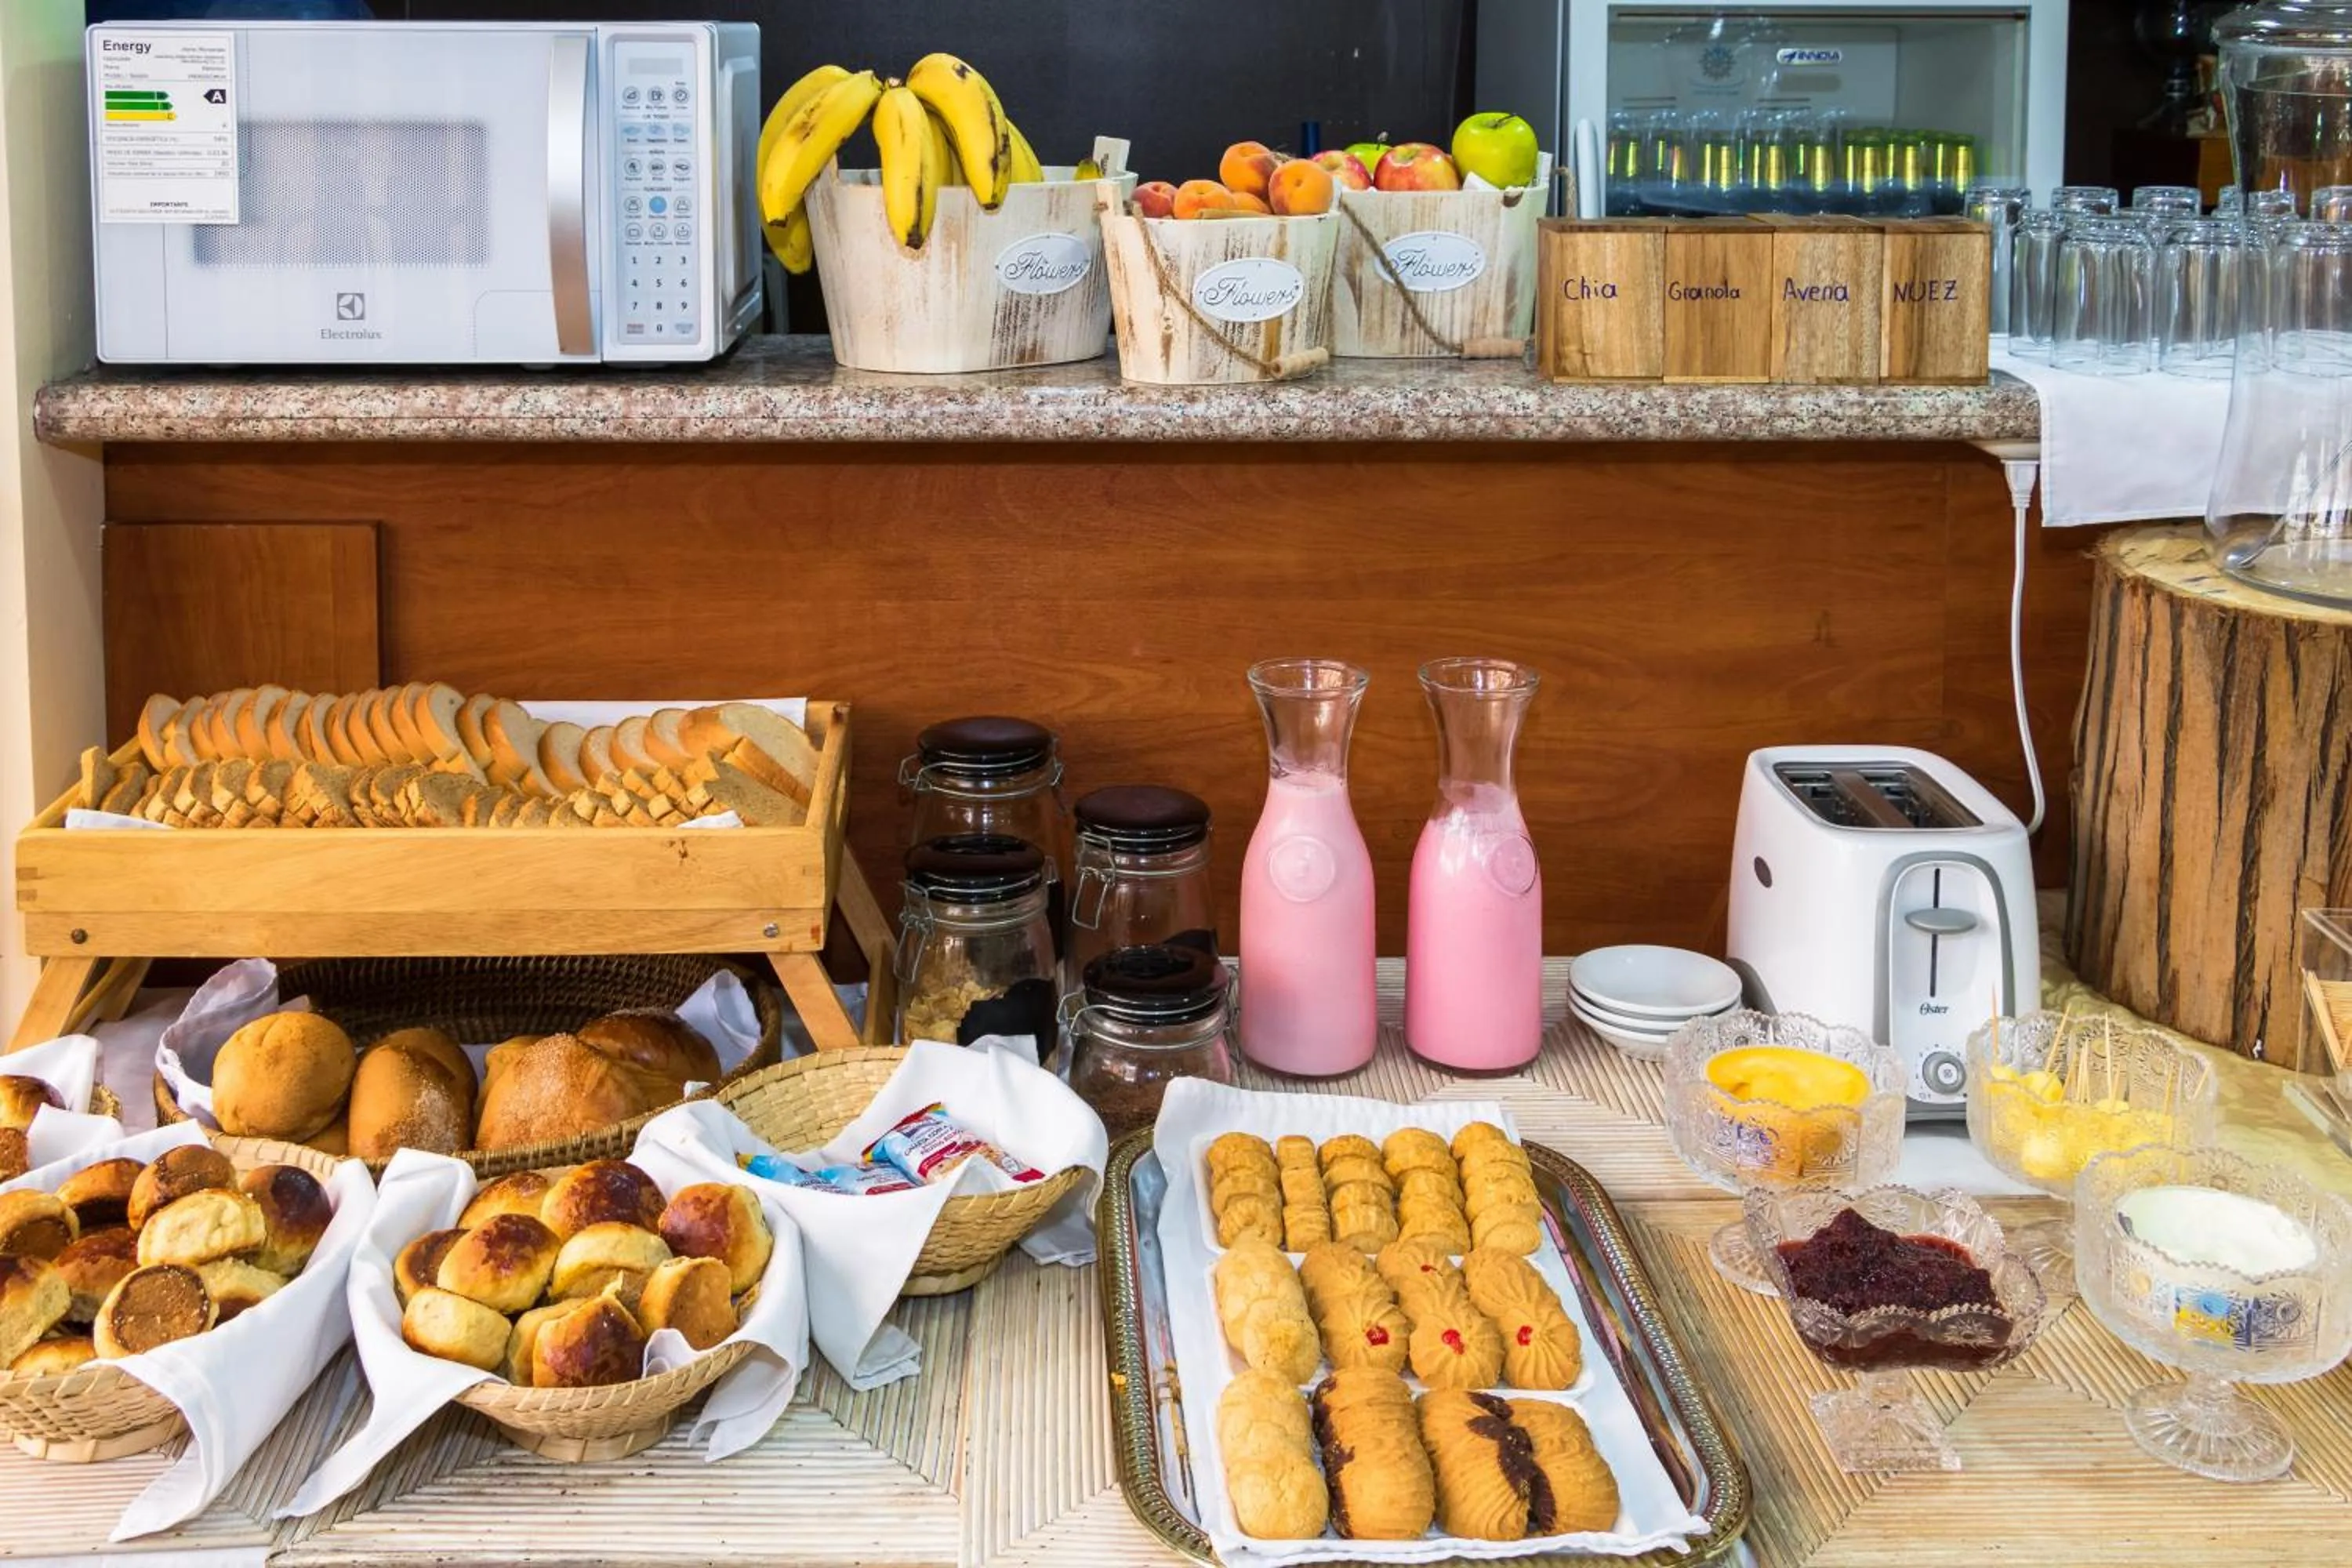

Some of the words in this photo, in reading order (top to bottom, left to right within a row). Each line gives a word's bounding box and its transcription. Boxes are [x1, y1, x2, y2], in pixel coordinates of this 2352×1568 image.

[103, 39, 151, 54] Energy
[212, 91, 224, 102] A
[1004, 250, 1083, 280] Flowers
[1388, 248, 1476, 277] Flowers
[1202, 276, 1298, 307] Flowers
[1563, 276, 1618, 301] Chia
[1668, 280, 1740, 301] Granola
[1783, 278, 1850, 303] Avena
[1893, 279, 1959, 304] NUEZ
[681, 302, 687, 310] 9
[320, 328, 383, 339] Electrolux
[656, 324, 662, 332] 0
[1919, 1003, 1950, 1015] Oster
